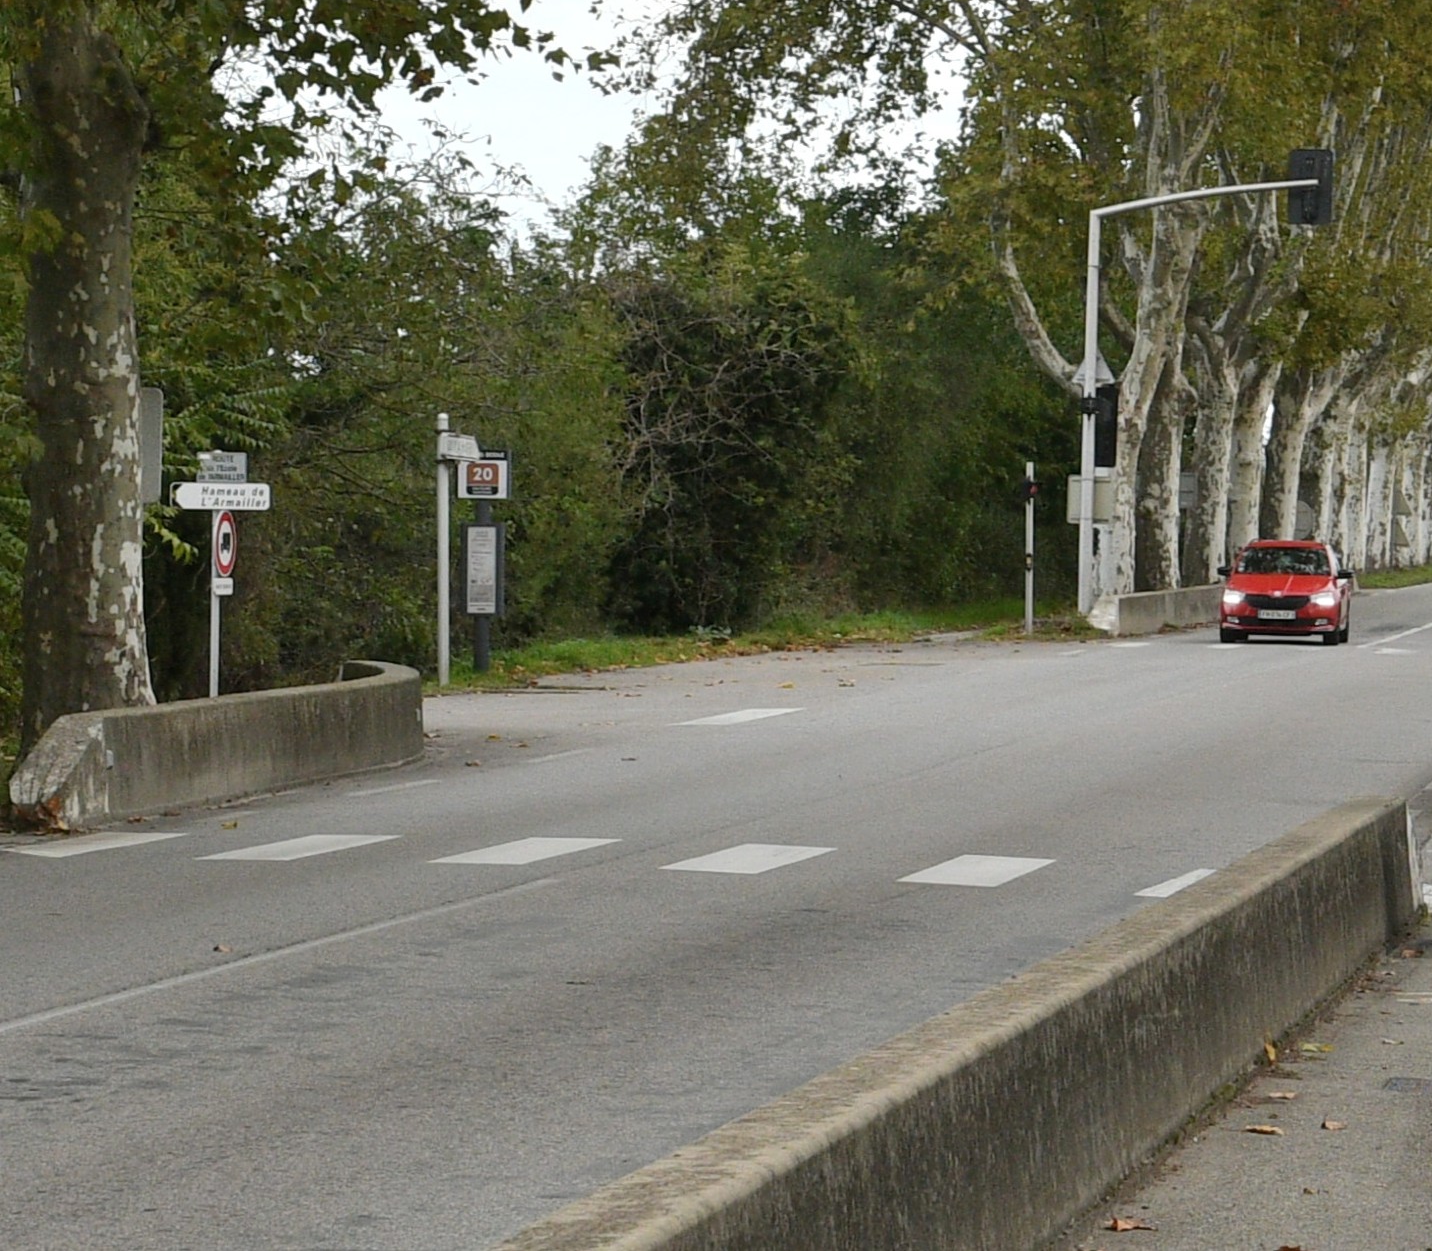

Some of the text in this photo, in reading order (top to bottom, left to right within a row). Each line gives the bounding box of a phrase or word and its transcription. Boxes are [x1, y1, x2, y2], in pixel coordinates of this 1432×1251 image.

[472, 467, 493, 481] 20
[201, 486, 264, 497] Hameau de
[201, 497, 267, 508] L'Armailler
